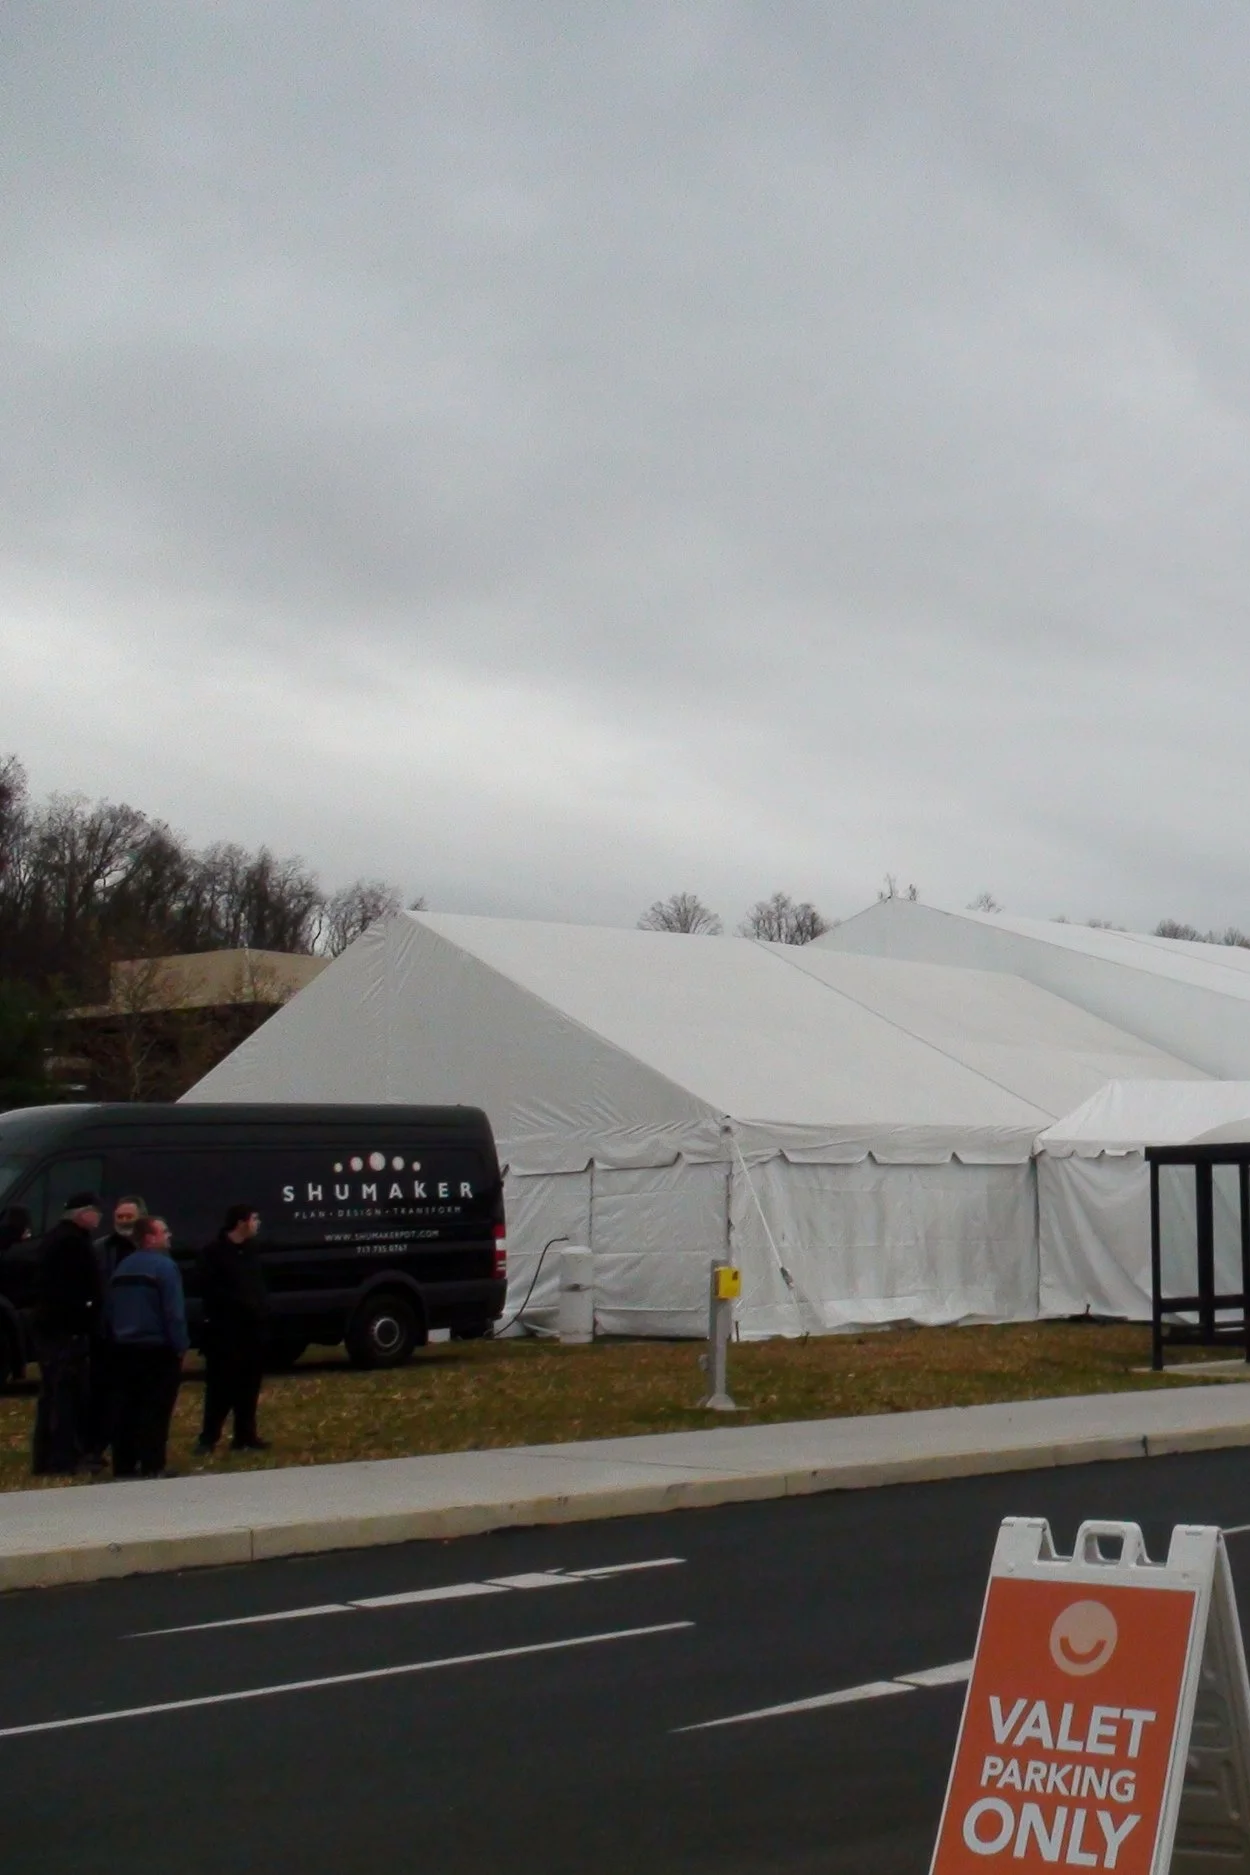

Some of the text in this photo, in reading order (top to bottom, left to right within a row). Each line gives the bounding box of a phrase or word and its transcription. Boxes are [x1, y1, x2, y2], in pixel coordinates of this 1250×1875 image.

[283, 1180, 473, 1201] SHUMAKER
[294, 1206, 462, 1219] PLAN DESIGN TRANSFORM
[989, 1695, 1156, 1758] VALET
[980, 1756, 1136, 1803] PARKING
[963, 1797, 1141, 1869] ONLY
